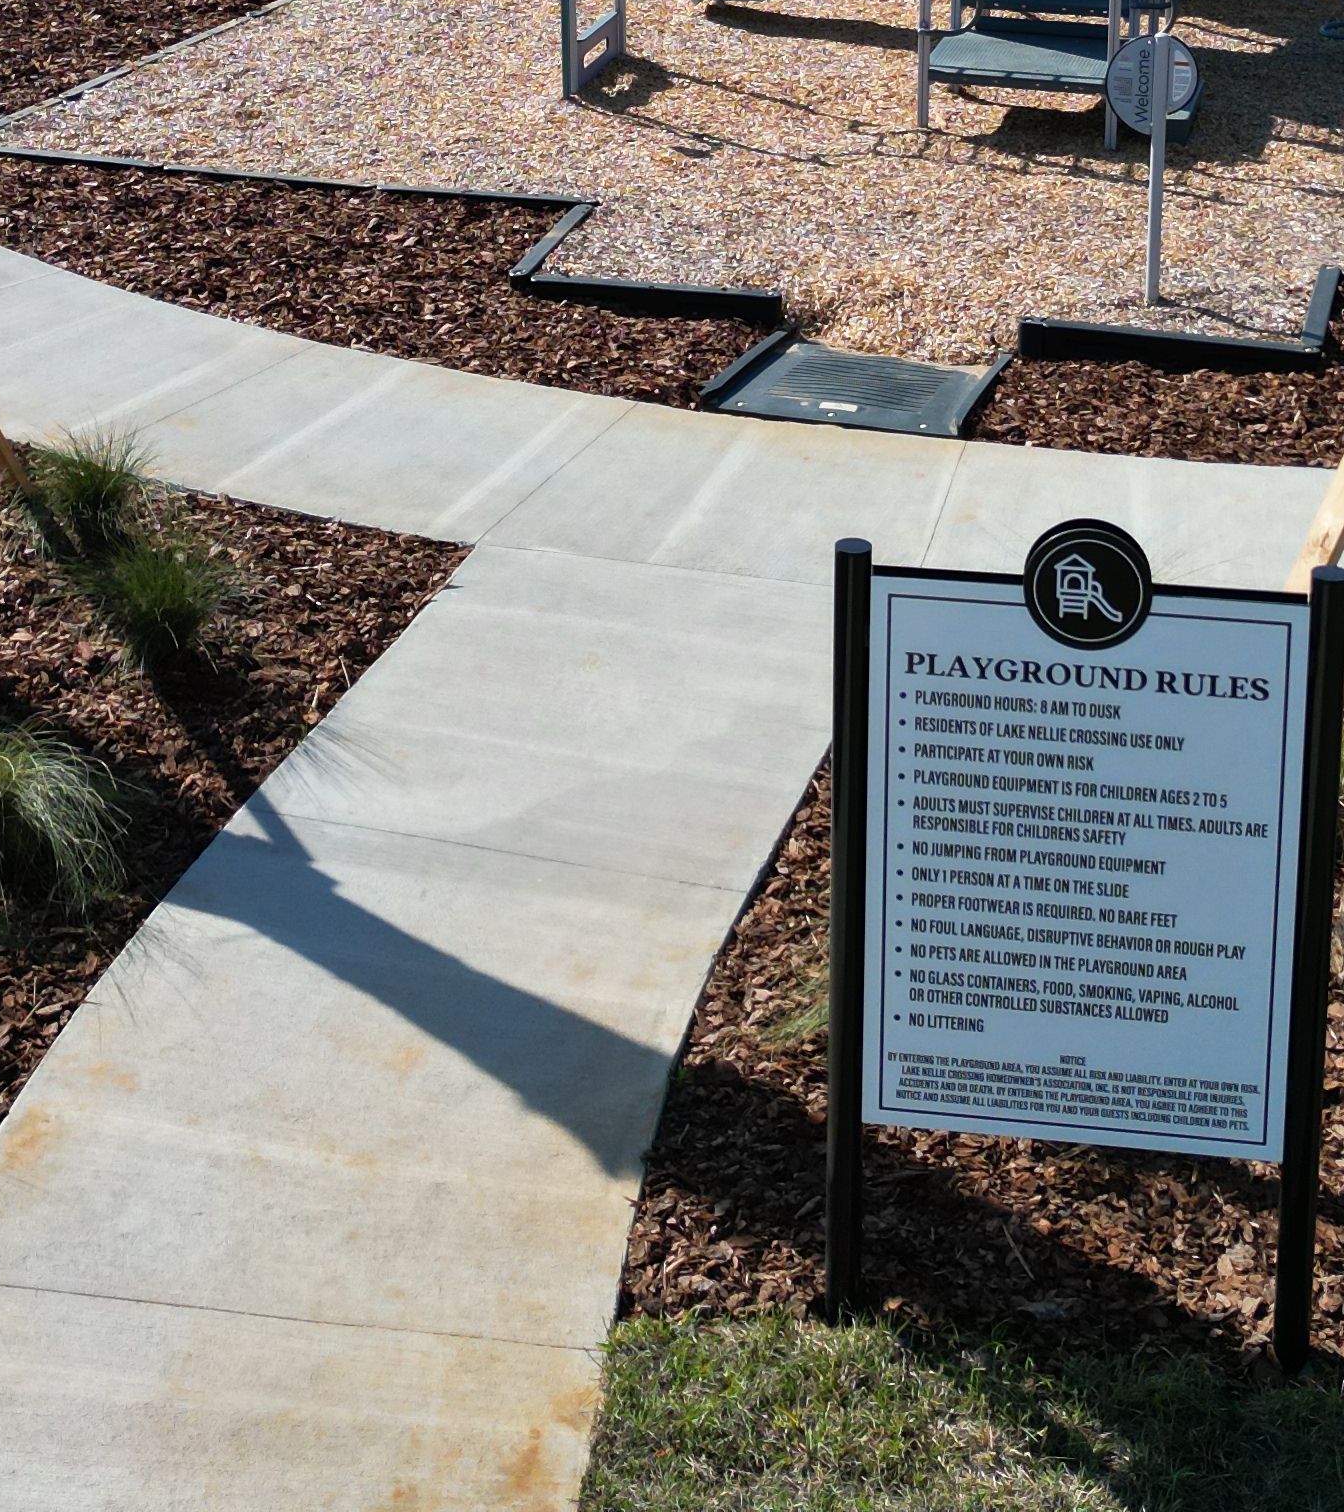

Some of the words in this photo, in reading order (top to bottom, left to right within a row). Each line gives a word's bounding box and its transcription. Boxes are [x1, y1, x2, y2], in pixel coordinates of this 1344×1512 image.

[1134, 49, 1151, 124] Welcome
[904, 651, 1147, 691] PLAYGROUND
[1154, 670, 1269, 701] RULES
[914, 689, 991, 710] PLAYGROUND
[993, 695, 1037, 713] HOURS:
[1039, 699, 1048, 714] 8
[1049, 699, 1069, 716] AM
[1071, 701, 1086, 717] TO
[1088, 702, 1121, 720] DUSK
[914, 716, 977, 735] RESIDENTS
[978, 721, 994, 737] OF
[996, 722, 1026, 739] LAKE
[1027, 724, 1067, 743] NELLIE
[1068, 728, 1127, 747] CROSSING
[1129, 732, 1153, 749] USE
[1154, 734, 1185, 751] ONLY
[913, 742, 985, 763] PARTICIPATE
[986, 748, 1002, 764] AT
[1002, 749, 1034, 766] YOUR
[1036, 752, 1064, 769] OWN
[1066, 754, 1094, 771] RISK
[913, 768, 990, 789] PLAYGROUND
[992, 775, 1060, 795] EQUIPMENT
[1061, 780, 1073, 796] IS
[1074, 781, 1098, 798] FOR
[1099, 783, 1157, 803] CHILDREN
[1159, 788, 1190, 805] AGES
[1192, 791, 1200, 806] 2
[1201, 791, 1218, 808] TO
[1219, 793, 1227, 808] 5
[912, 795, 956, 813] ADULTS
[957, 798, 991, 816] MUST
[992, 801, 1055, 821] SUPERVISE
[1057, 806, 1114, 826] CHILDREN
[1116, 811, 1132, 827] AT
[1132, 813, 1154, 829] ALL
[1156, 814, 1196, 832] TIMES.
[1197, 818, 1243, 836] ADULTS
[1244, 822, 1269, 838] ARE
[912, 814, 989, 835] RESPONSIBLE
[991, 820, 1014, 837] FOR
[1016, 822, 1080, 842] CHILDRENS
[1082, 828, 1126, 846] SAFETY
[912, 840, 928, 856] NO
[930, 841, 981, 860] JUMPING
[983, 846, 1017, 863] FROM
[1019, 849, 1096, 869] PLAYGROUND
[1098, 855, 1166, 875] EQUIPMENT
[911, 866, 940, 882] ONLY
[942, 869, 946, 883] 1
[949, 869, 995, 887] PERSON
[996, 873, 1011, 888] AT
[1012, 874, 1021, 889] A
[1022, 875, 1051, 892] TIME
[1053, 877, 1070, 894] ON
[1071, 879, 1094, 896] THE
[1095, 881, 1129, 898] SLIDE
[911, 891, 955, 910] PROPER
[957, 895, 1020, 916] FOOTWEAR
[1022, 901, 1033, 916] IS
[1035, 902, 1096, 922] REQUIRED.
[1098, 907, 1115, 923] NO
[1117, 909, 1148, 926] BARE
[1150, 912, 1178, 928] FEET
[910, 917, 927, 933] NO
[929, 918, 958, 936] FOUL
[960, 921, 1024, 943] LANGUAGE,
[1026, 927, 1094, 947] DISRUPTIVE
[1095, 933, 1153, 952] BEHAVIOR
[1155, 938, 1172, 954] OR
[1173, 939, 1214, 957] ROUGH
[1216, 943, 1246, 960] PLAY
[910, 943, 926, 958] NO
[928, 944, 957, 961] PETS
[958, 947, 981, 963] ARE
[982, 949, 1036, 968] ALLOWED
[1039, 954, 1051, 969] IN
[1053, 955, 1076, 971] THE
[1077, 957, 1154, 978] PLAYGROUND
[1155, 964, 1187, 981] AREA
[909, 968, 926, 984] NO
[927, 970, 965, 987] GLASS
[966, 973, 1040, 995] CONTAINERS,
[1042, 980, 1076, 998] FOOD,
[1078, 983, 1136, 1003] SMOKING,
[1138, 988, 1184, 1008] VAPING,
[1186, 992, 1240, 1011] ALCOHOL
[909, 987, 925, 1002] OR
[926, 988, 963, 1005] OTHER
[965, 991, 1037, 1012] CONTROLLED
[1039, 998, 1112, 1019] SUBSTANCES
[1114, 1005, 1169, 1023] ALLOWED
[908, 1012, 924, 1027] NO
[927, 1013, 984, 1032] LITTERING
[887, 1051, 897, 1062] BY
[898, 1052, 934, 1065] ENTERING
[935, 1055, 949, 1067] THE
[951, 1056, 1000, 1071] PLAYGROUND
[1025, 1063, 1040, 1075] YOU
[1041, 1065, 1072, 1078] ASSUME
[1073, 1068, 1087, 1079] ALL
[1089, 1069, 1106, 1080] RISK
[1107, 1071, 1123, 1083] AND
[1163, 1076, 1187, 1089] ENTER
[1188, 1078, 1197, 1090] AT
[1199, 1079, 1219, 1091] YOUR
[1220, 1081, 1239, 1093] OWN
[1059, 1054, 1086, 1066] NOTICE
[898, 1076, 939, 1090] ACCIDENTS
[940, 1080, 956, 1092] AND
[957, 1082, 968, 1093] OR
[996, 1085, 1006, 1096] BY
[1007, 1086, 1043, 1100] ENTERING
[1045, 1090, 1059, 1101] THE
[1060, 1091, 1110, 1106] PLAYGROUND
[1134, 1098, 1150, 1110] YOU
[1151, 1100, 1176, 1112] AGREE
[1177, 1102, 1187, 1113] TO
[1219, 1106, 1229, 1117] TO
[1230, 1107, 1248, 1119] THIS
[901, 1064, 920, 1076] LAKE
[921, 1066, 946, 1078] NELLIE
[947, 1068, 984, 1082] CROSSING
[1111, 1084, 1119, 1094] IS
[1120, 1085, 1136, 1096] NOT
[1193, 1091, 1208, 1103] FOR
[895, 1088, 921, 1101] NOTICE
[922, 1091, 938, 1102] AND
[939, 1092, 970, 1105] ASSUME
[972, 1095, 985, 1106] ALL
[986, 1097, 1028, 1110] LIABILITIES
[1029, 1101, 1044, 1112] FOR
[1045, 1102, 1060, 1113] YOU
[1061, 1104, 1078, 1115] AND
[1079, 1105, 1099, 1117] YOUR
[1100, 1107, 1129, 1120] GUESTS
[1172, 1114, 1210, 1127] CHILDREN
[1211, 1117, 1227, 1129] AND
